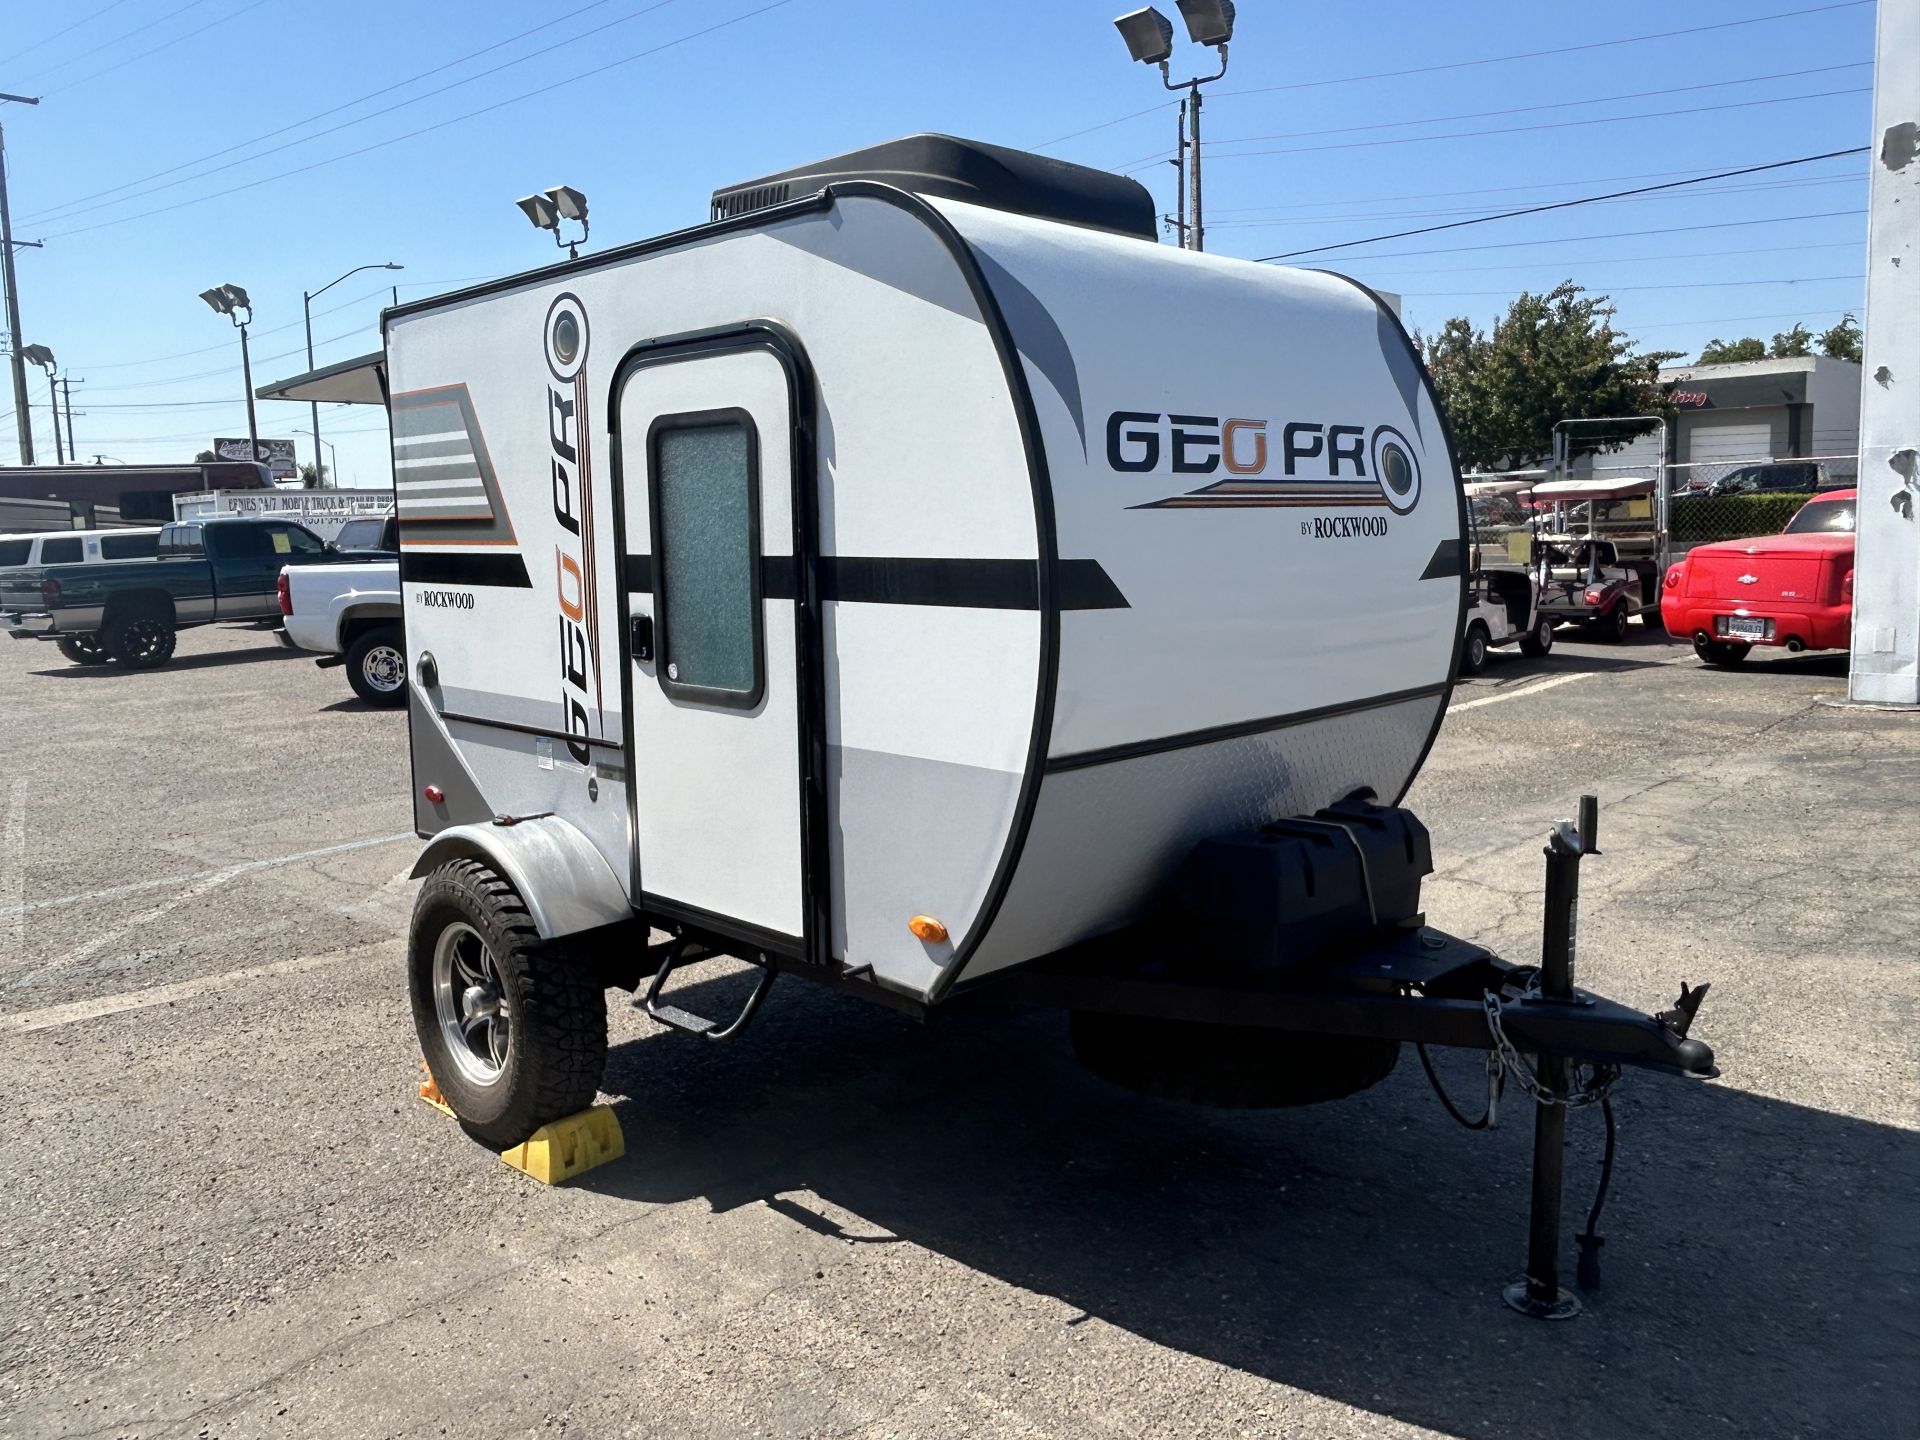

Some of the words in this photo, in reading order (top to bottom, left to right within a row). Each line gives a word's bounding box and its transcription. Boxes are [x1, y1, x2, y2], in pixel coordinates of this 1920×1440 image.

[544, 291, 590, 537] PRO
[1106, 410, 1268, 475] GEO
[1283, 421, 1422, 516] PRO
[311, 496, 336, 511] TRUCK
[1301, 521, 1313, 536] BY
[1313, 516, 1388, 538] ROCKWOOD
[423, 590, 475, 610] ROCKWOOD
[556, 543, 591, 767] GEO
